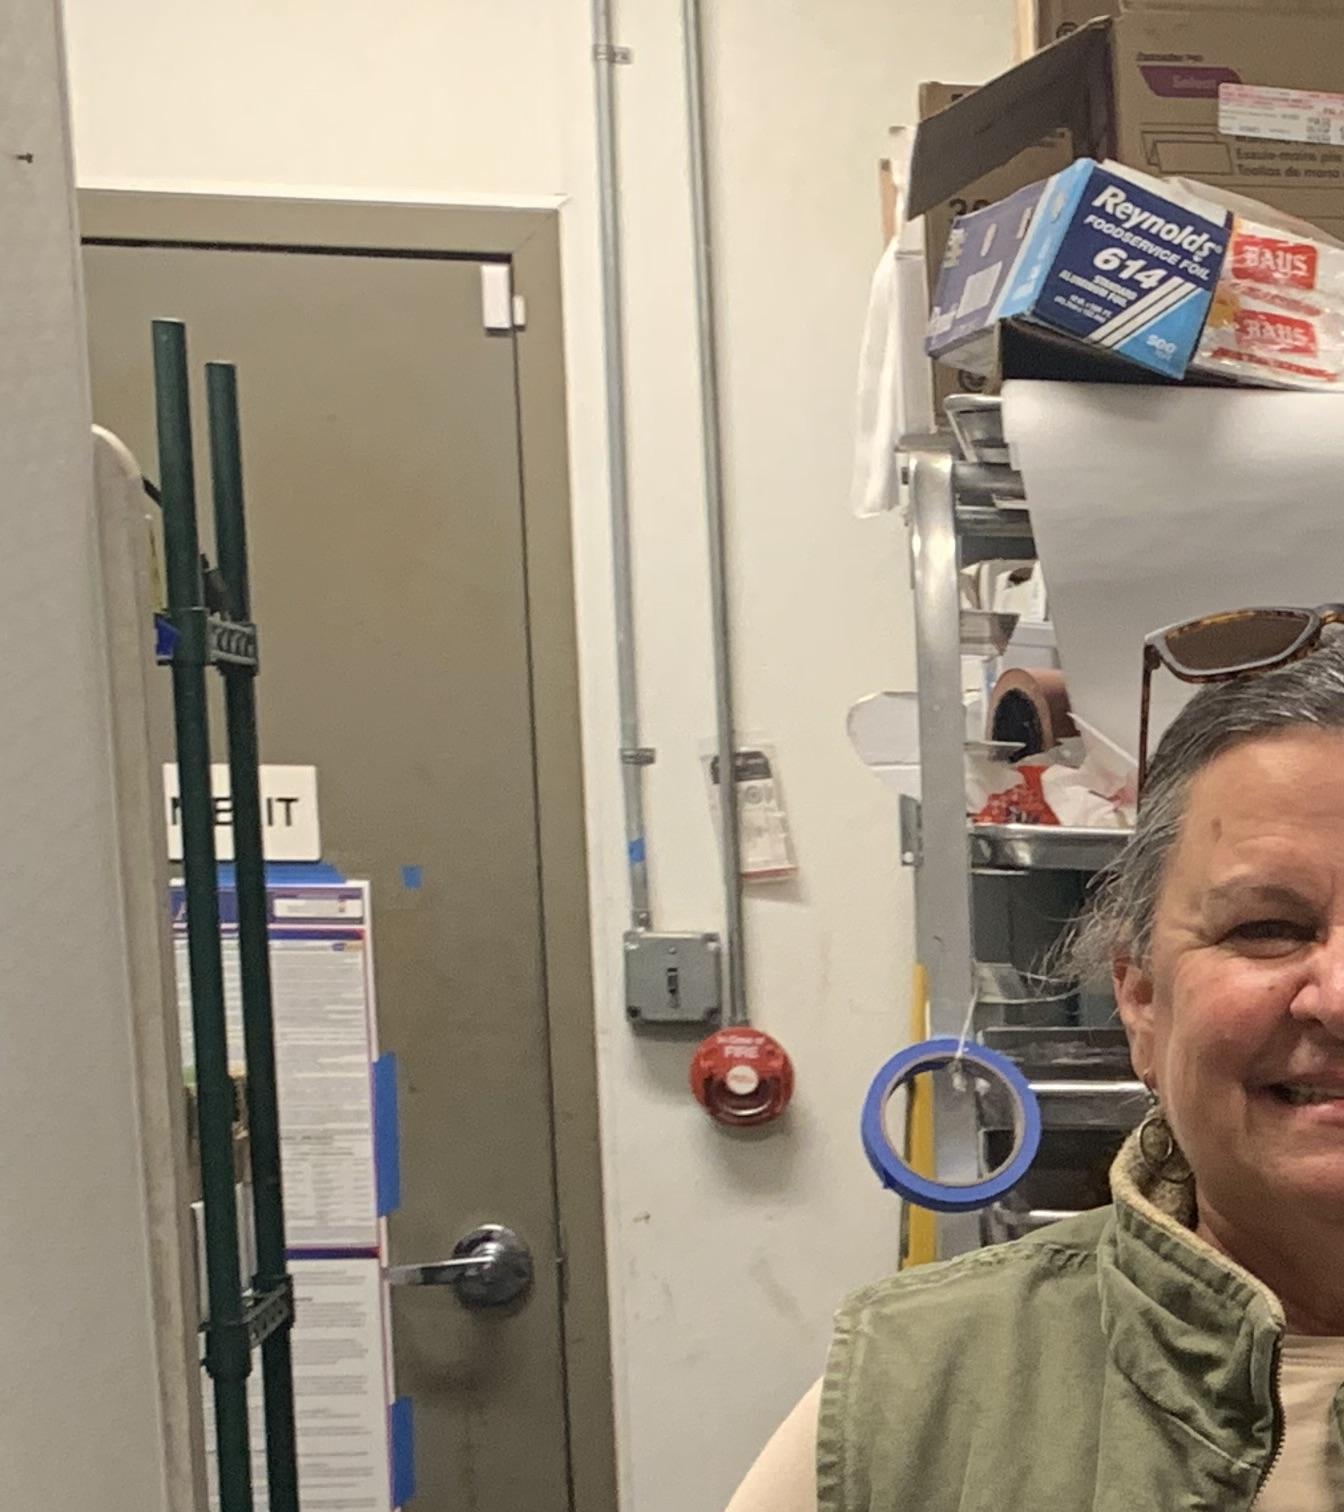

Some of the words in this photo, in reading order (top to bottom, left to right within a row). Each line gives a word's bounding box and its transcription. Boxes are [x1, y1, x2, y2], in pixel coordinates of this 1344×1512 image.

[1084, 214, 1180, 266] FOODSERVICE
[1179, 258, 1210, 281] FOIL
[1092, 184, 1217, 261] Reynolds
[1093, 247, 1168, 290] 614
